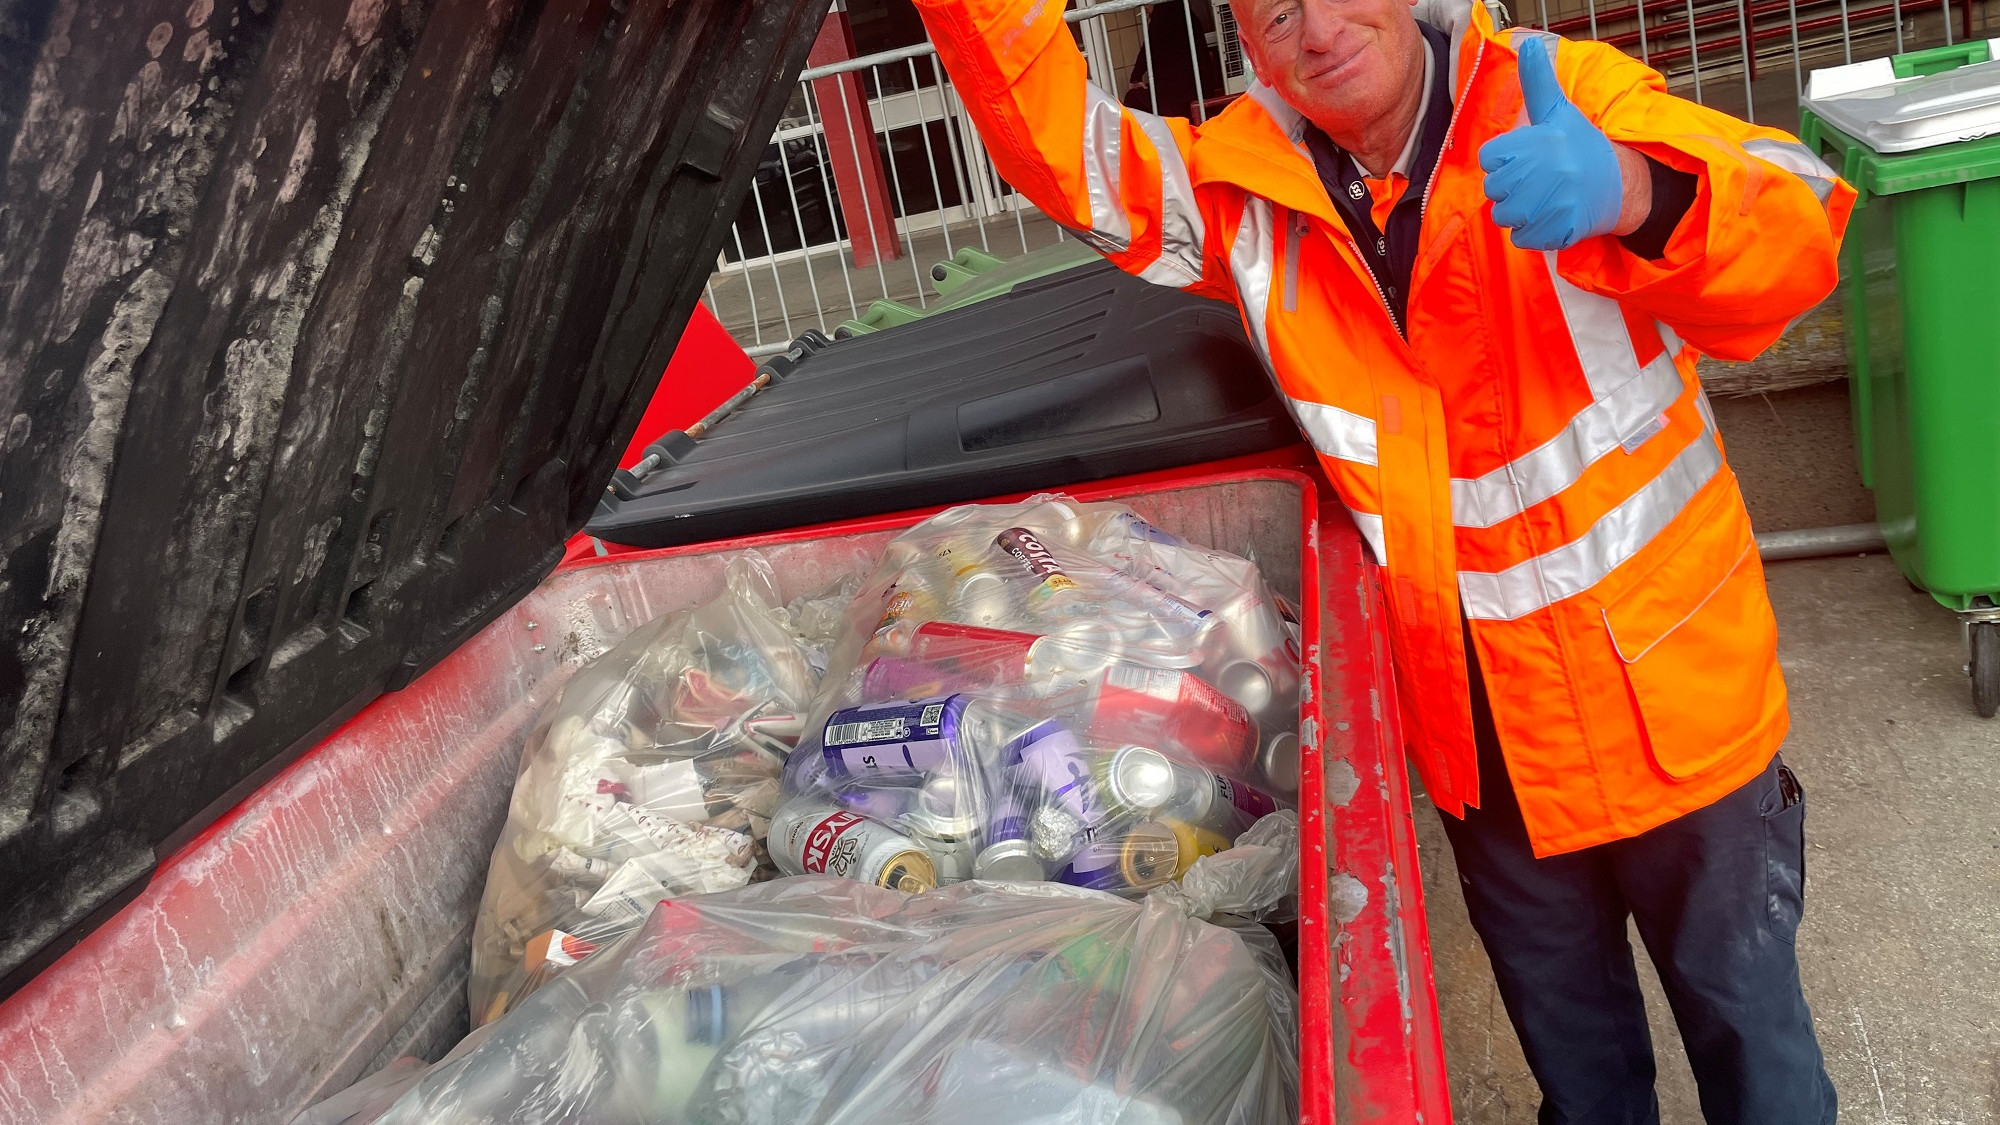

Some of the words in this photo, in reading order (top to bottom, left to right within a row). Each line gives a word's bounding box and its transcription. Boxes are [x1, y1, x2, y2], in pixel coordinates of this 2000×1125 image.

[1011, 547, 1035, 572] COFFEE
[1019, 534, 1063, 574] COSTA
[806, 811, 861, 874] TYSK
